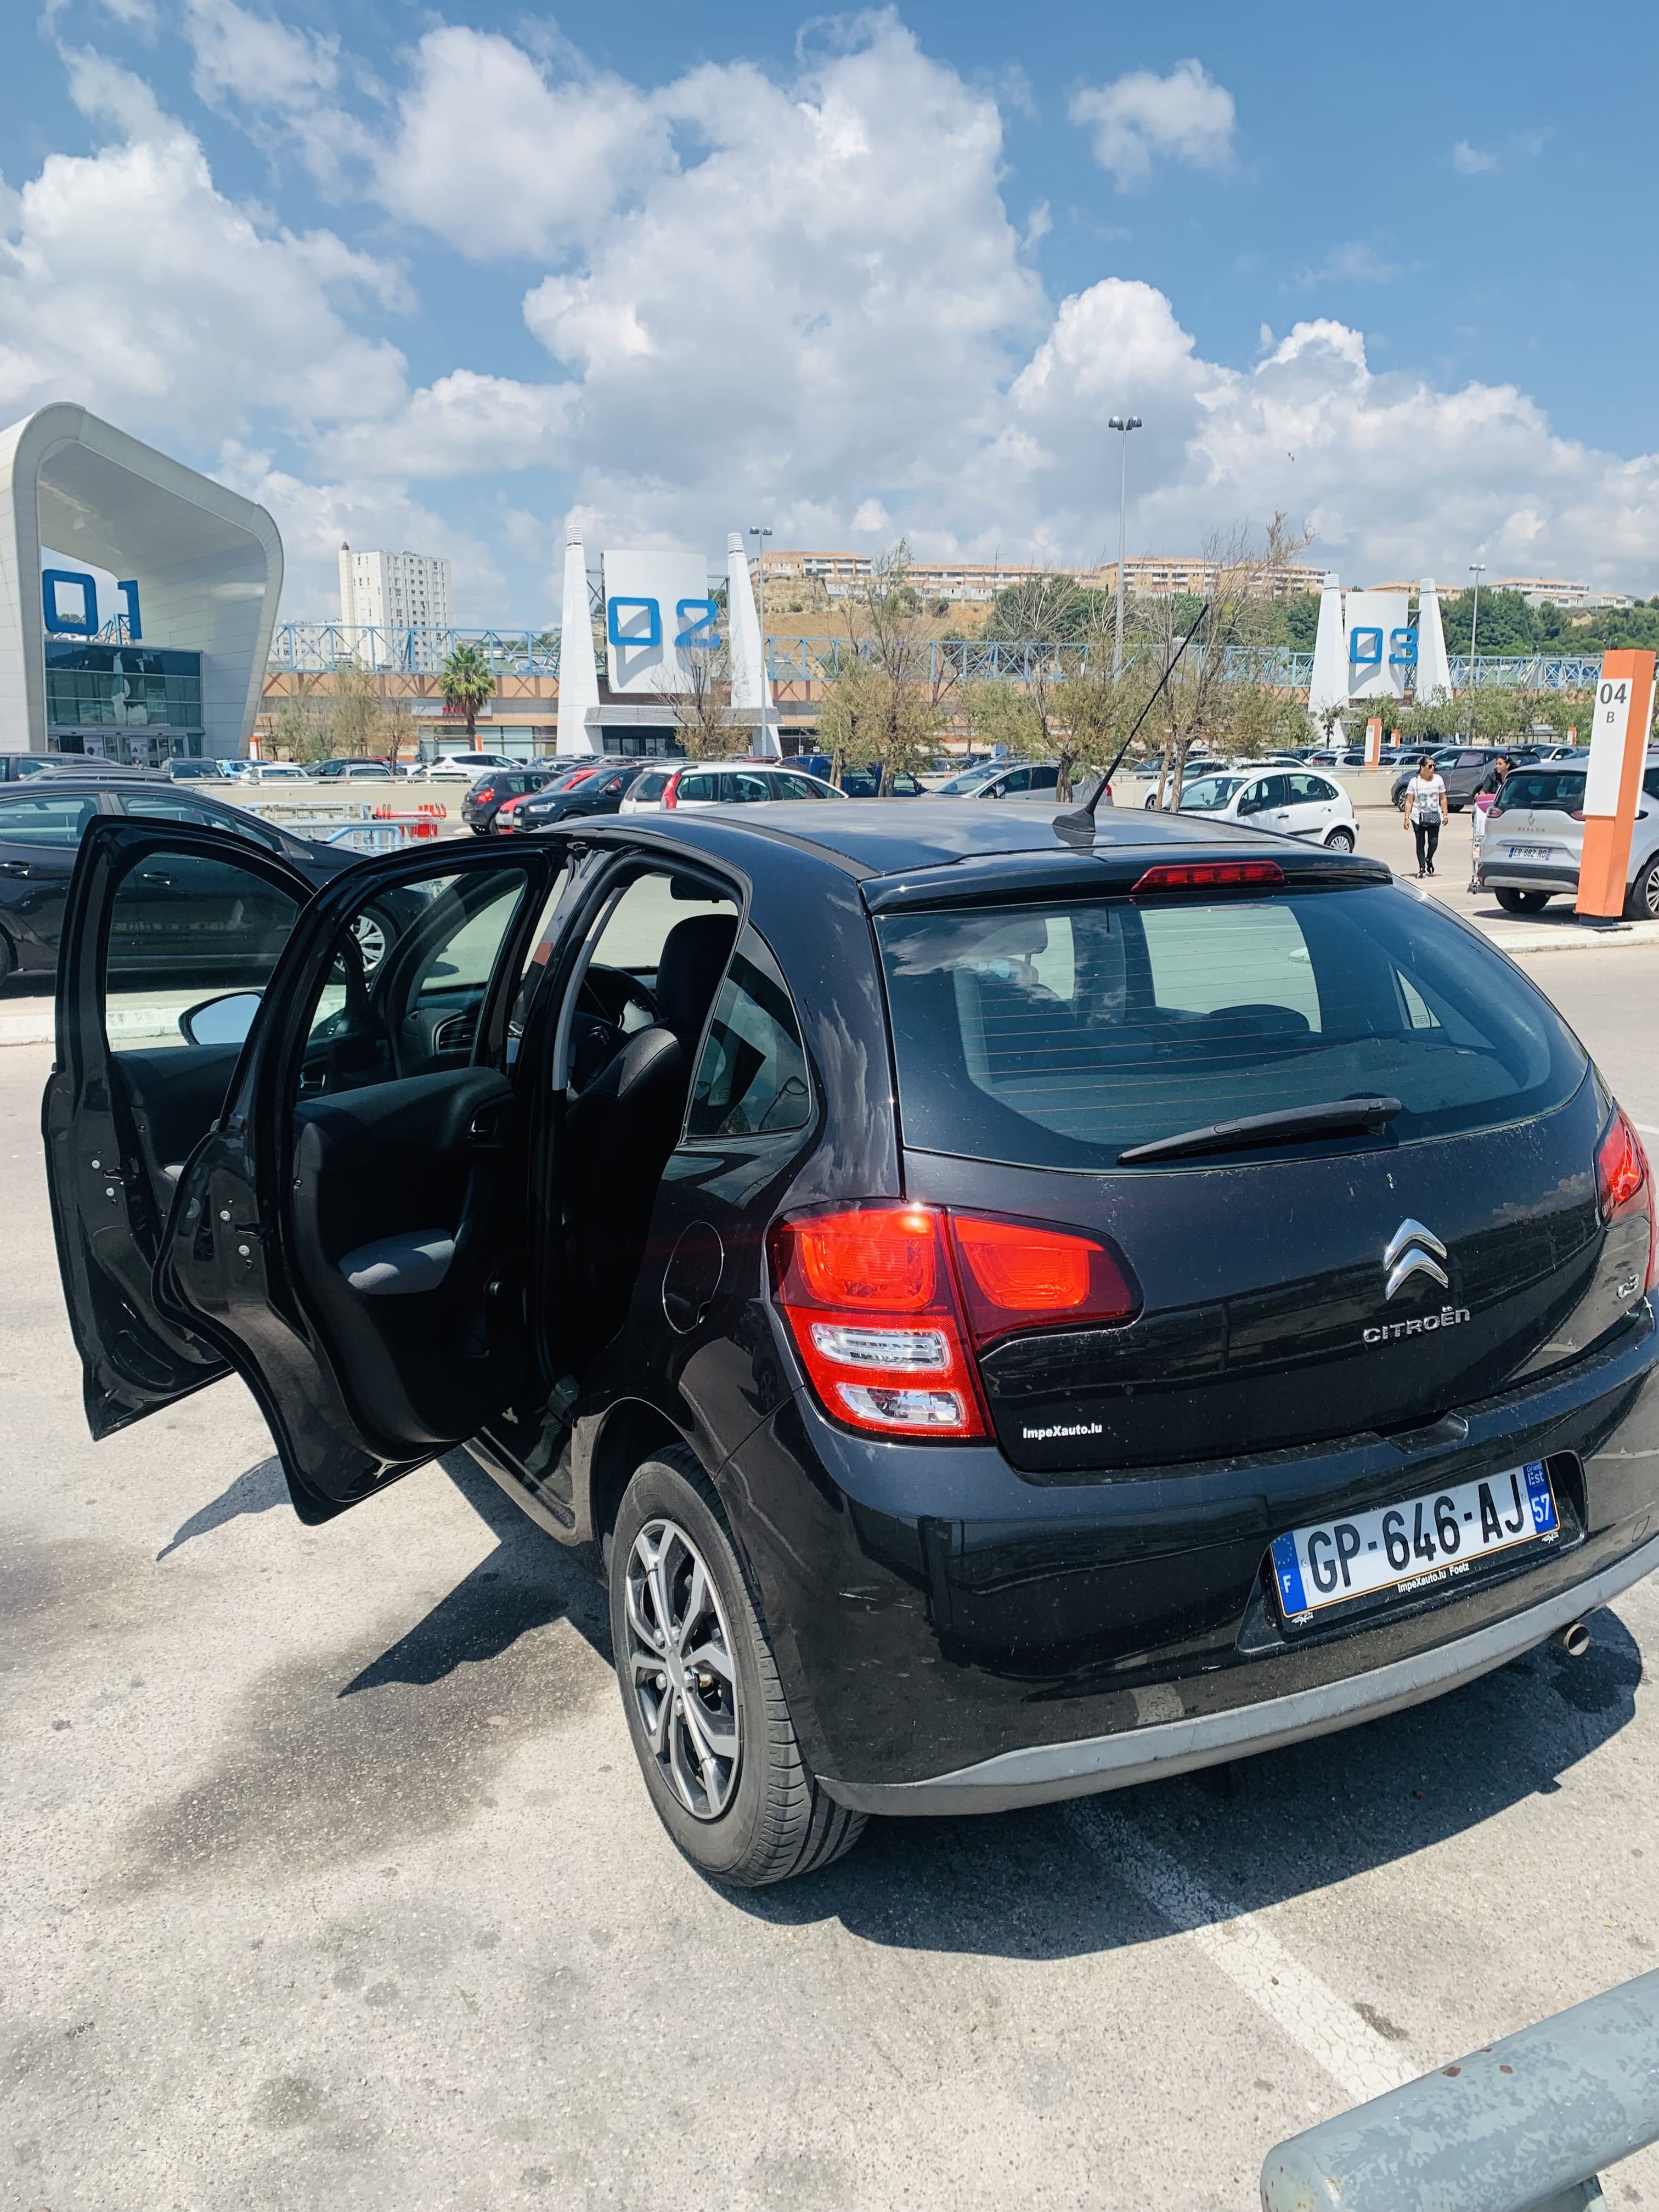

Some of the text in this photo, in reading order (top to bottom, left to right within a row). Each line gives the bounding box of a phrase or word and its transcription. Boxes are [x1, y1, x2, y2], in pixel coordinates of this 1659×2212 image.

[42, 569, 142, 639] 01
[608, 597, 720, 648] 02
[1350, 627, 1418, 664] 03
[1600, 683, 1627, 704] 04
[1606, 712, 1615, 723] B
[1618, 1273, 1639, 1299] C3
[1023, 1423, 1102, 1441] ImpeXauto.lu
[1526, 1462, 1542, 1473] Grand
[1528, 1470, 1544, 1486] Est
[1531, 1493, 1550, 1523] 57
[1307, 1474, 1525, 1593] GP-646-AJ
[1283, 1575, 1291, 1593] F
[1397, 1562, 1470, 1593] ImpeXauto.lu Foetz
